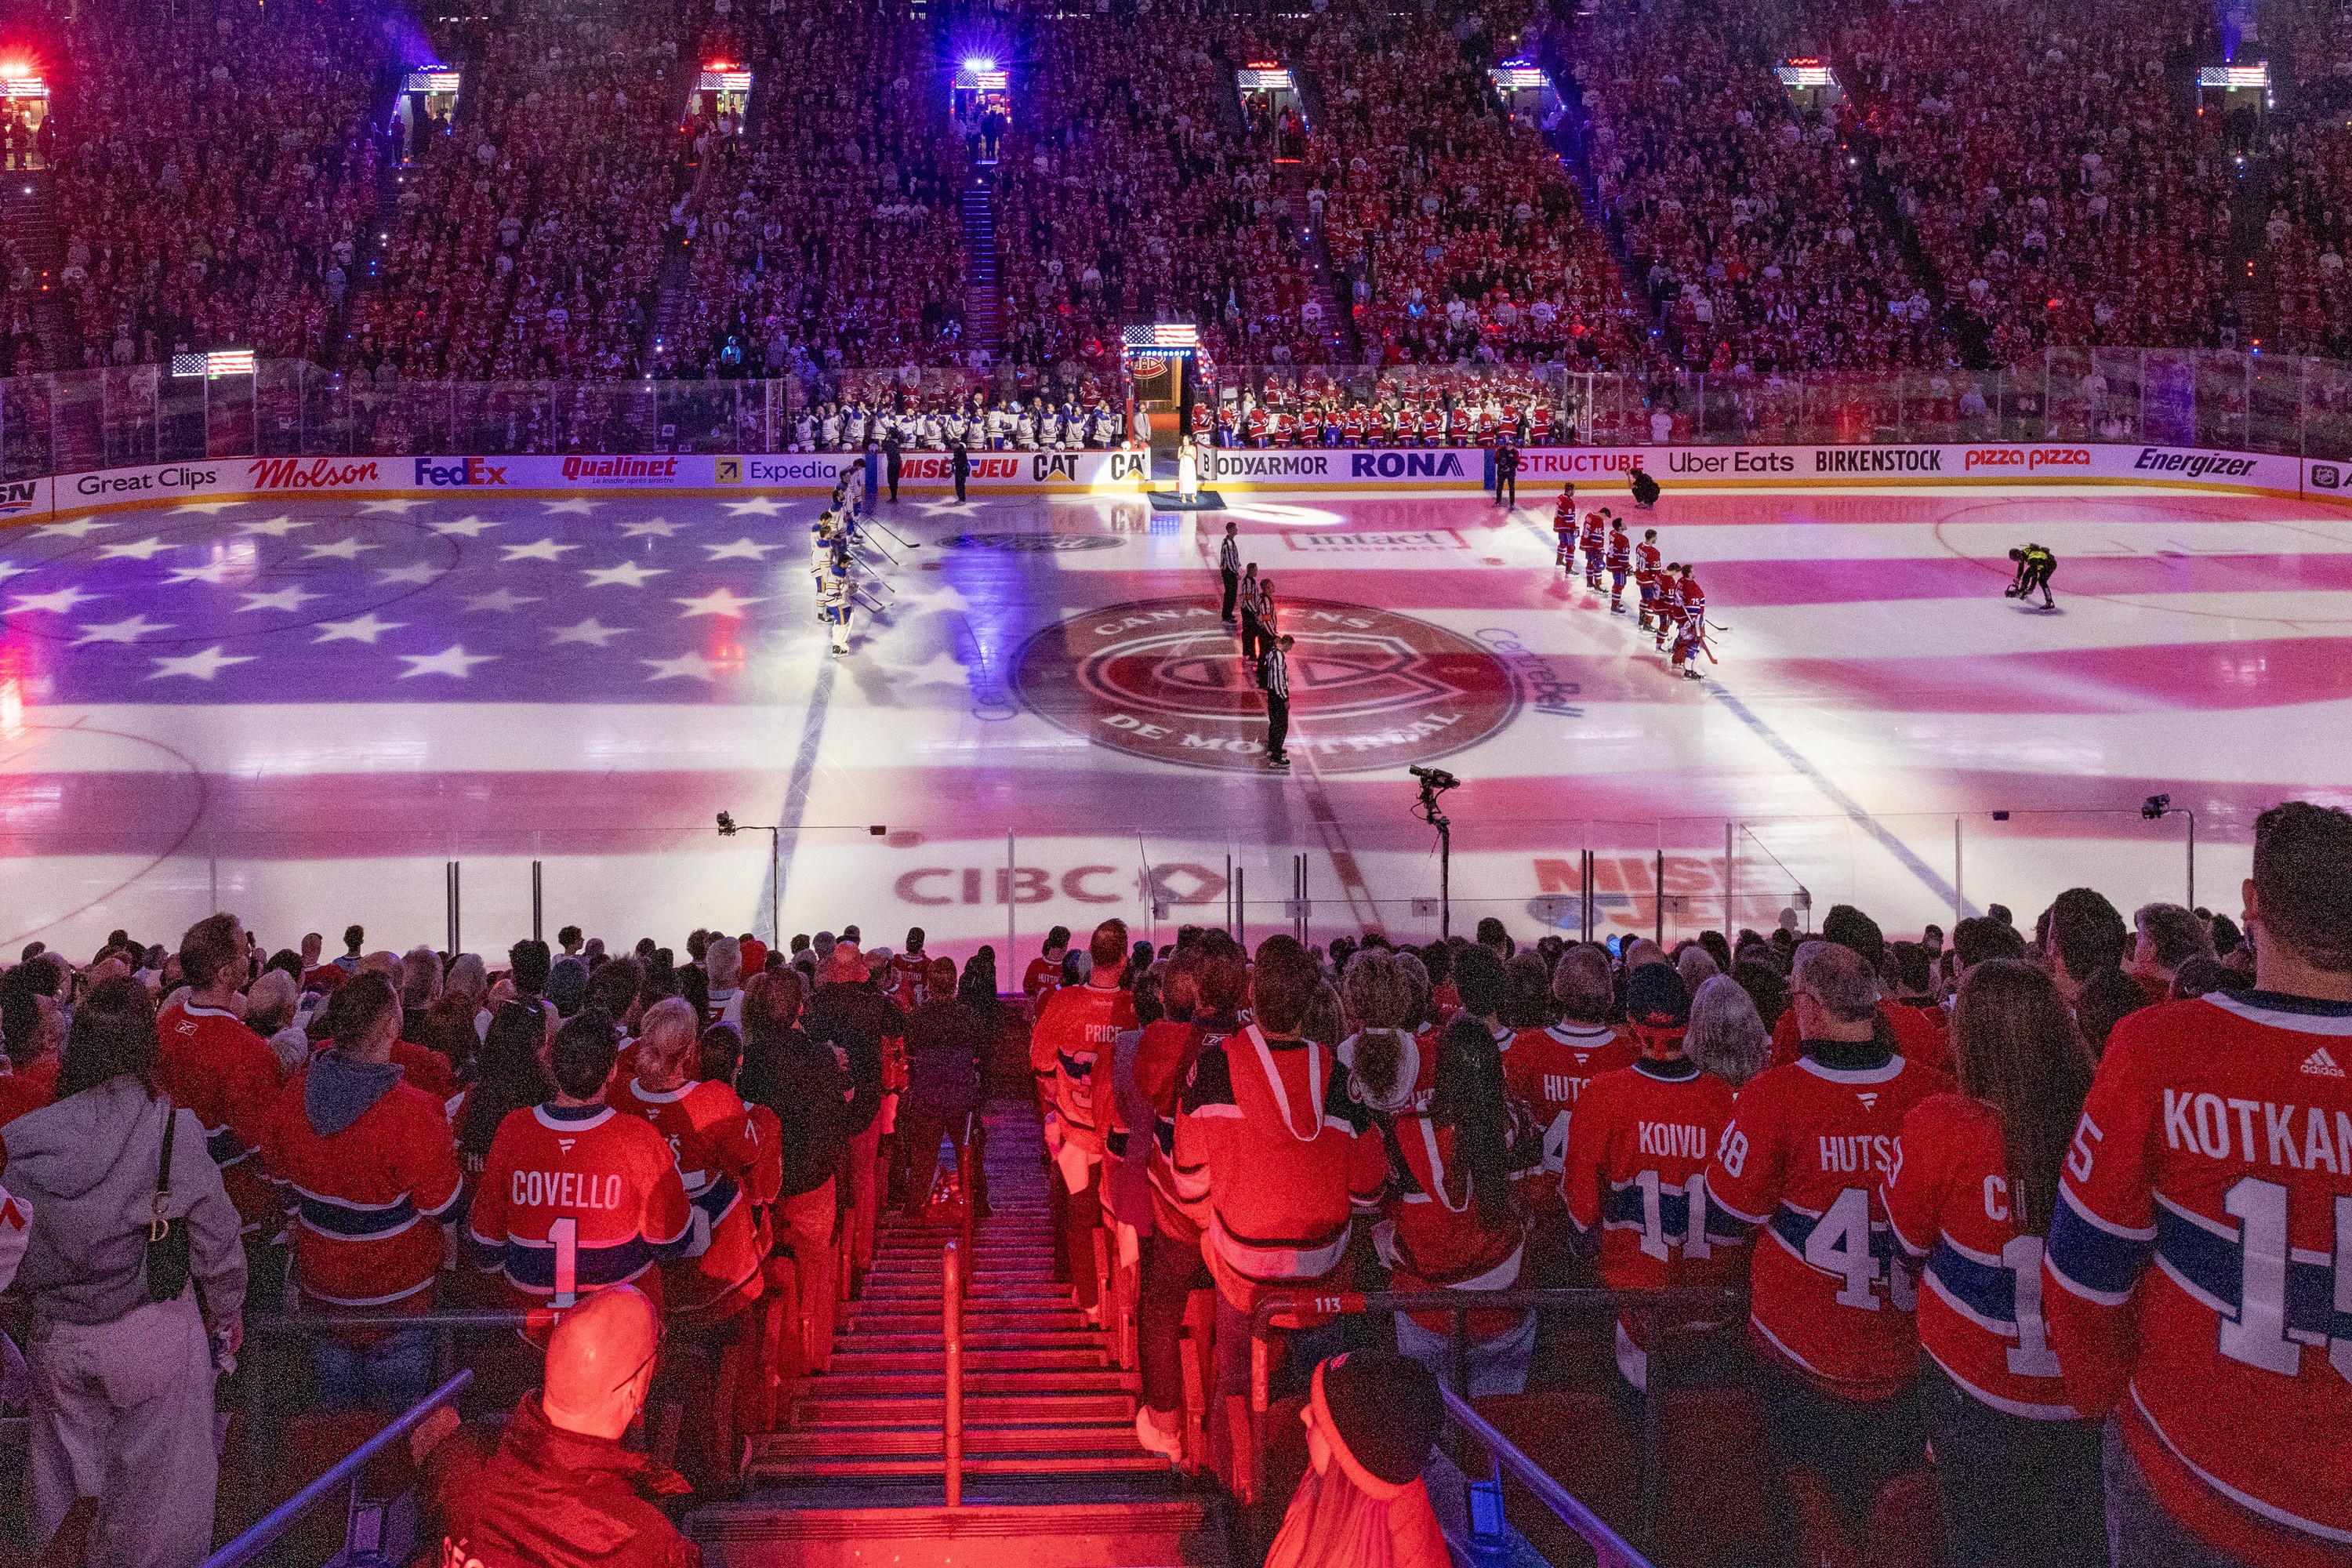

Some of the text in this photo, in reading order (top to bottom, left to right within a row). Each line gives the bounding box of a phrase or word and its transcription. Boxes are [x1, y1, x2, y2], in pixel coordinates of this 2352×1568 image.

[248, 458, 379, 488] Molson
[415, 458, 508, 486] FedEx
[561, 456, 678, 481] Qualinet
[750, 462, 837, 481] Expedia
[1033, 454, 1079, 482] CAT
[1111, 454, 1145, 481] CA
[1352, 453, 1464, 477] RONA
[1518, 455, 1644, 472] STRUCTUBE
[1668, 452, 1794, 473] Uber Eats
[1816, 450, 1941, 472] BIRKENSTOCK
[1965, 449, 2090, 471] pizza pizza
[2134, 448, 2257, 477] Energizer
[77, 468, 216, 495] Great Clips
[1102, 713, 1174, 740] DE
[895, 866, 1122, 905] CIBC
[1639, 1122, 1706, 1158] KOIVU
[512, 1171, 621, 1209] COVELLO
[1639, 1170, 1711, 1261] 11
[547, 1218, 578, 1308] 1
[1315, 1298, 1341, 1314] 113
